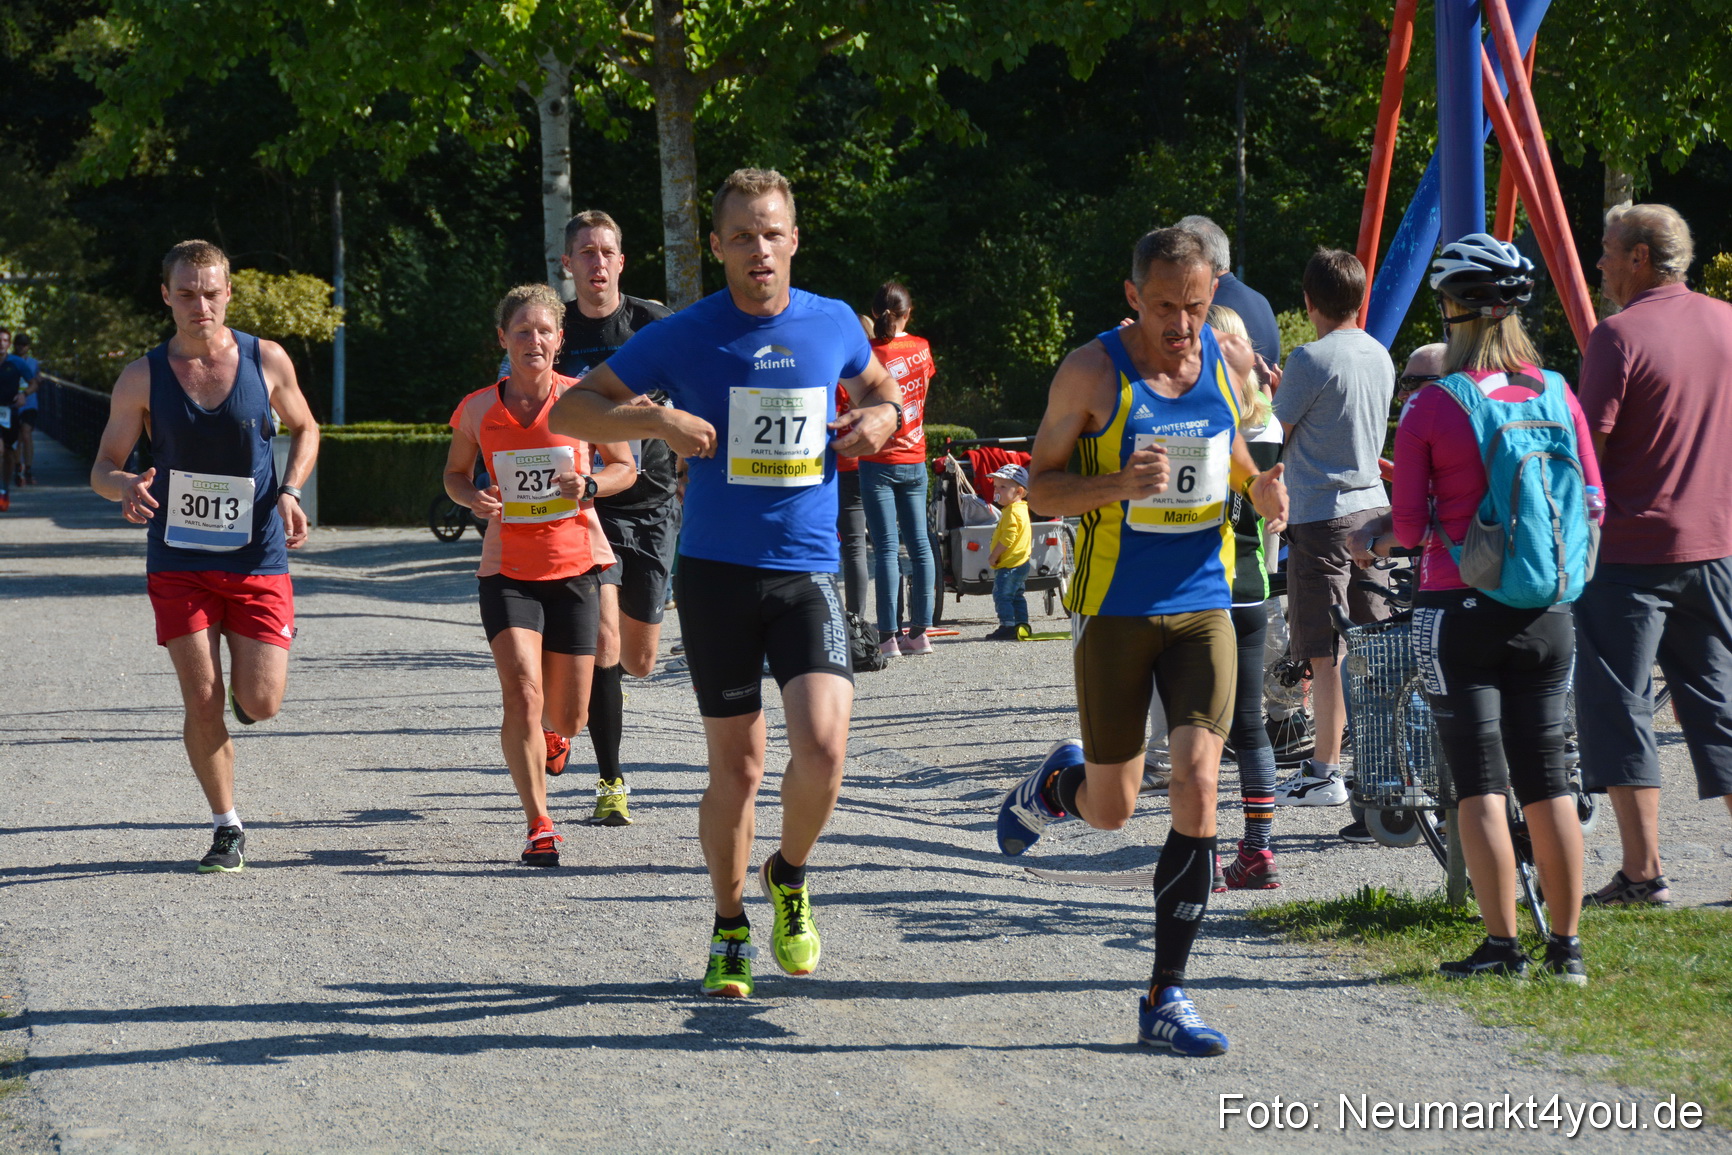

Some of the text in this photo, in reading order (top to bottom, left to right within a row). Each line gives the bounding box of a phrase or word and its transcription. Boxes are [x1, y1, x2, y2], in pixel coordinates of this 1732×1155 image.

[753, 358, 796, 370] skinfit
[760, 397, 804, 408] BOCK
[753, 415, 807, 445] 217
[1161, 419, 1210, 432] INTERSPORT
[516, 454, 551, 465] BOCK
[751, 461, 807, 477] Christoph
[192, 480, 229, 490] BOCK
[514, 469, 556, 492] 237
[1176, 465, 1196, 494] 6
[531, 493, 555, 501] Neumarkt
[1175, 497, 1205, 505] Neumarkt
[180, 493, 240, 521] 3013
[530, 505, 548, 515] Eva
[184, 519, 202, 527] PARTL
[1163, 510, 1198, 523] Mario
[822, 621, 833, 651] www.
[1421, 607, 1438, 652] ROTHSEE
